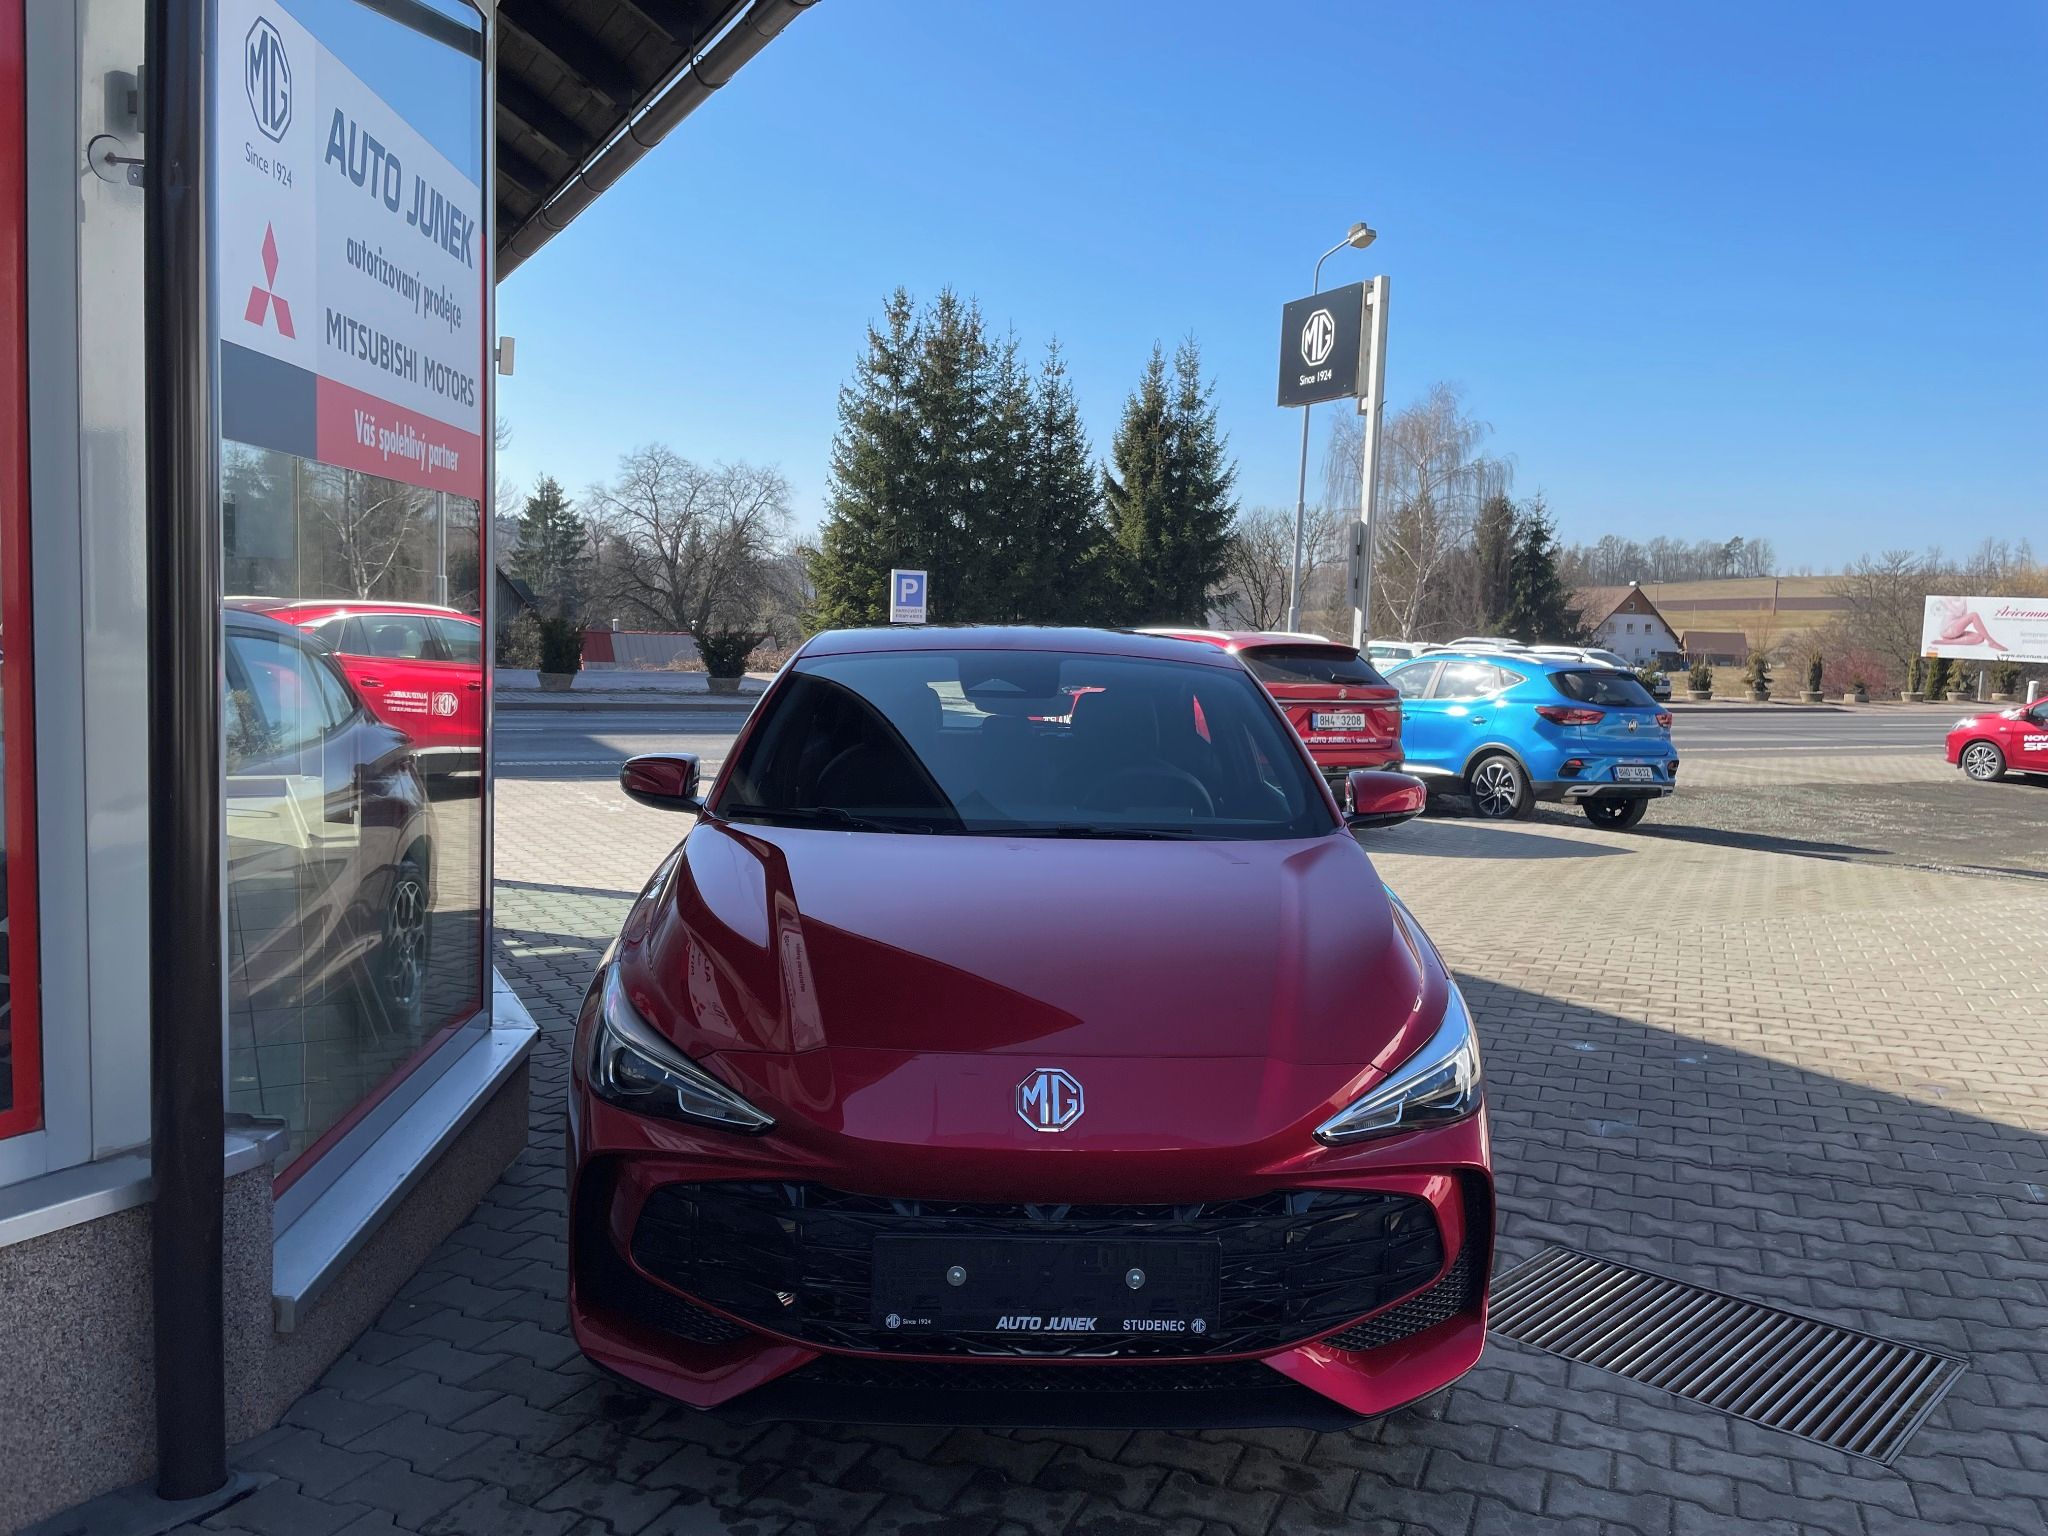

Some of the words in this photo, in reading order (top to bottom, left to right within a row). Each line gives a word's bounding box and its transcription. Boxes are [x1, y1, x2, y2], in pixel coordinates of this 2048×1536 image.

[248, 26, 290, 134] MG
[245, 141, 269, 175] Since
[272, 160, 292, 190] 1924
[324, 107, 402, 214] AUTO
[406, 174, 475, 270] JUNEK
[346, 237, 421, 314] autorizovaný
[423, 284, 462, 333] prodejce
[326, 307, 417, 384] MITSUBISHI
[424, 356, 475, 408] MOTORS
[1303, 312, 1333, 363] MG
[1299, 374, 1315, 386] Since
[1316, 369, 1332, 384] 1924
[354, 409, 376, 446] Váš
[378, 421, 426, 465] spolehlivý
[428, 443, 459, 474] partner
[900, 578, 919, 603] P
[1319, 715, 1335, 726] 8H4
[1341, 715, 1362, 726] 3208
[1019, 1071, 1081, 1128] MG
[885, 1314, 900, 1329] MG
[996, 1316, 1042, 1331] AUTO
[1043, 1316, 1098, 1331] JUNEK
[1123, 1319, 1186, 1332] STUDENEC
[1190, 1318, 1206, 1334] MG
